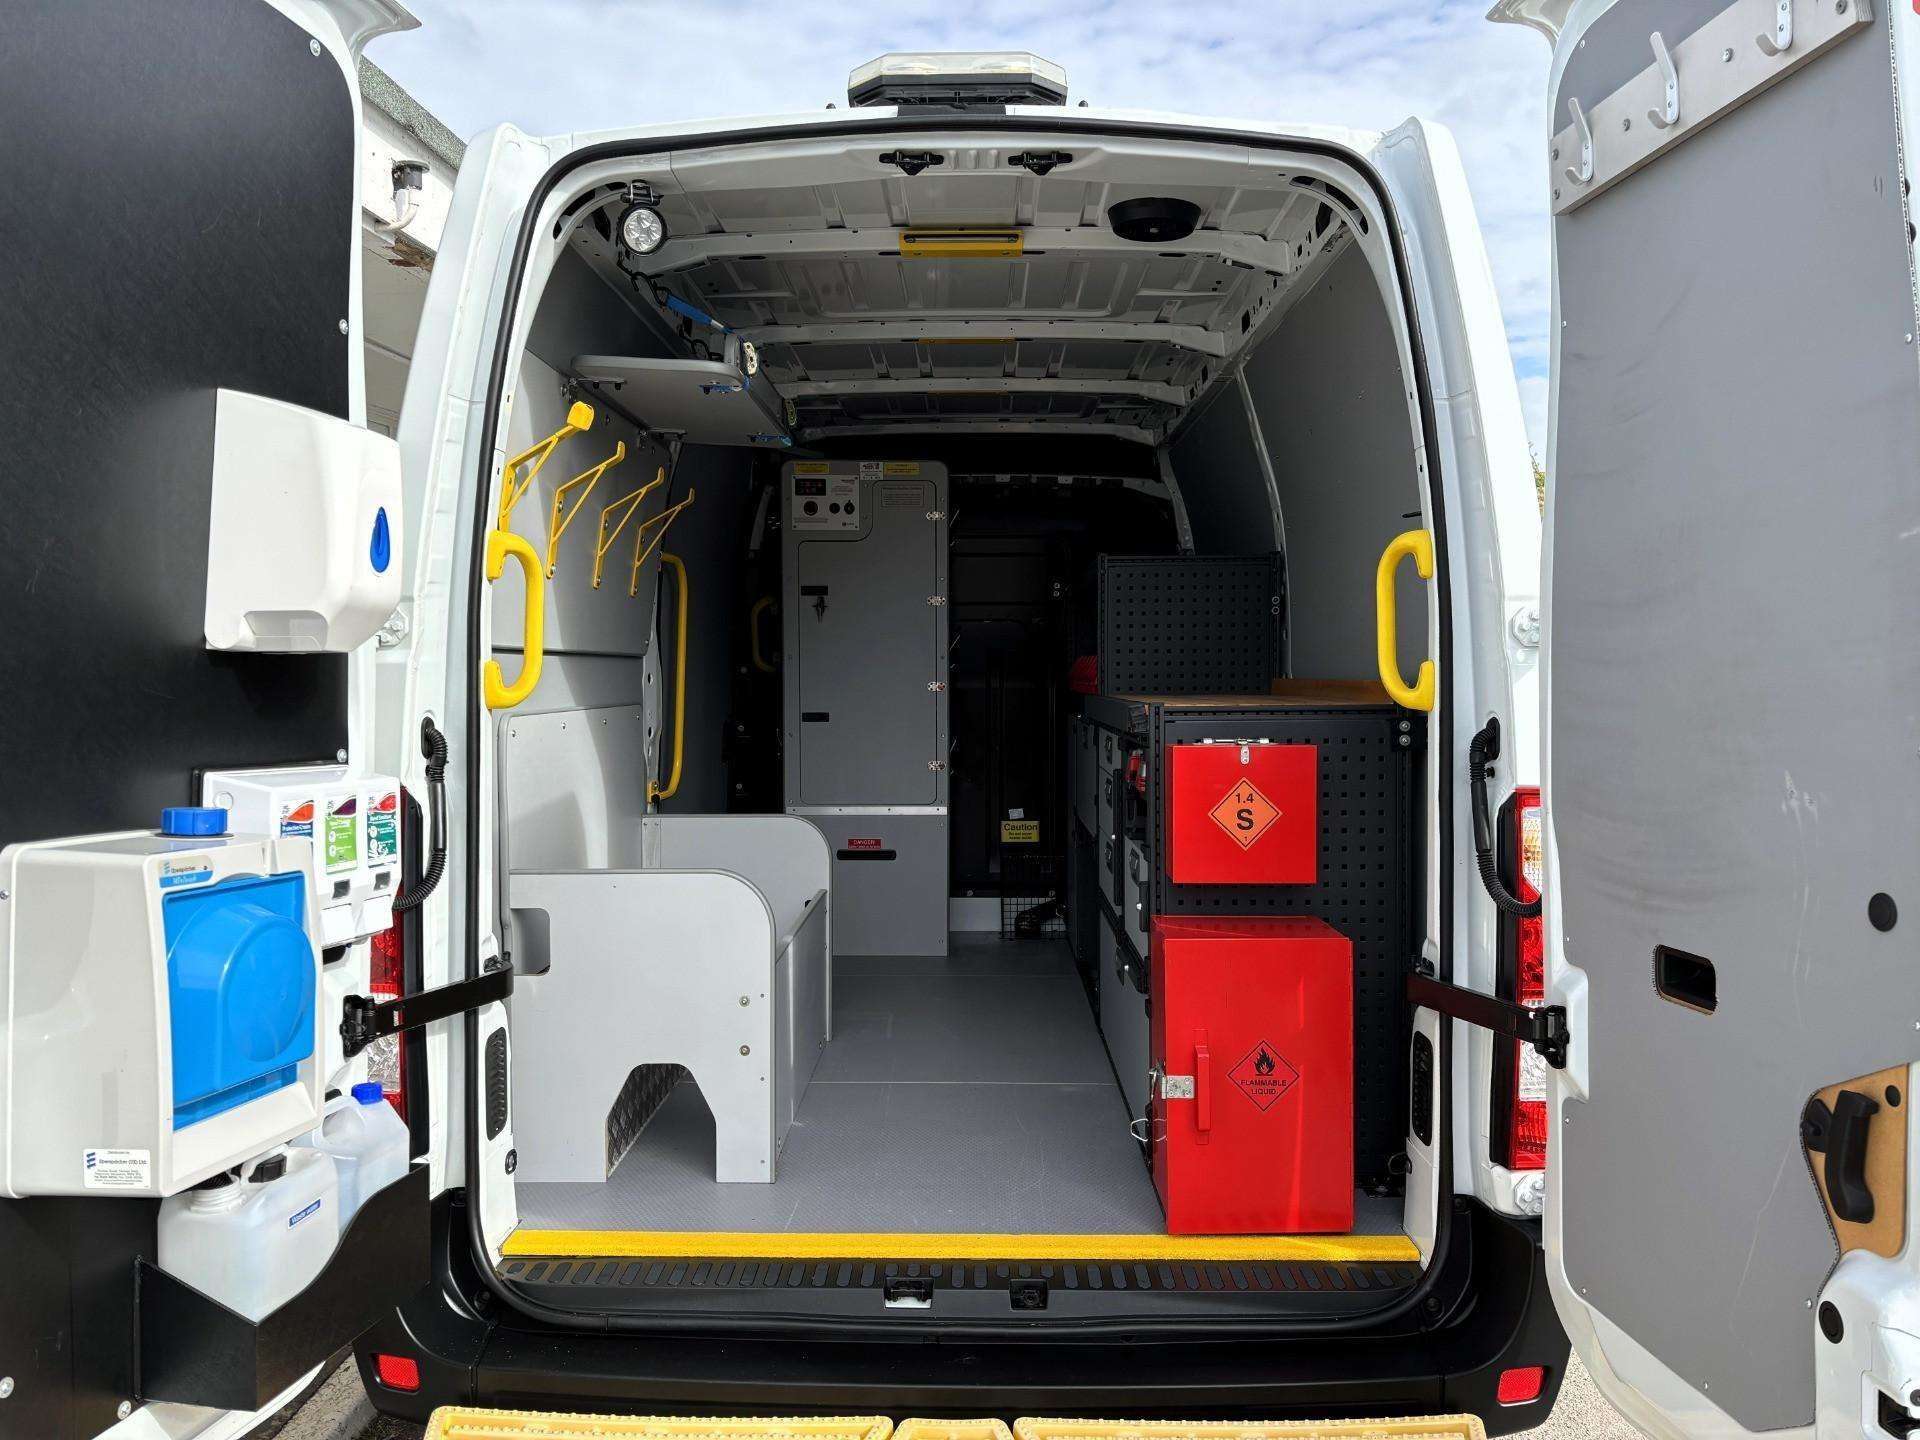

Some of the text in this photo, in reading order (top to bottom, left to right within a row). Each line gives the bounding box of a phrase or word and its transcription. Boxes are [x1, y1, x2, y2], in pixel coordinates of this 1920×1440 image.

[1235, 792, 1255, 804] 1.4
[1236, 808, 1255, 831] S
[1003, 823, 1038, 831] Caution
[1240, 1079, 1288, 1087] FLAMMABLE
